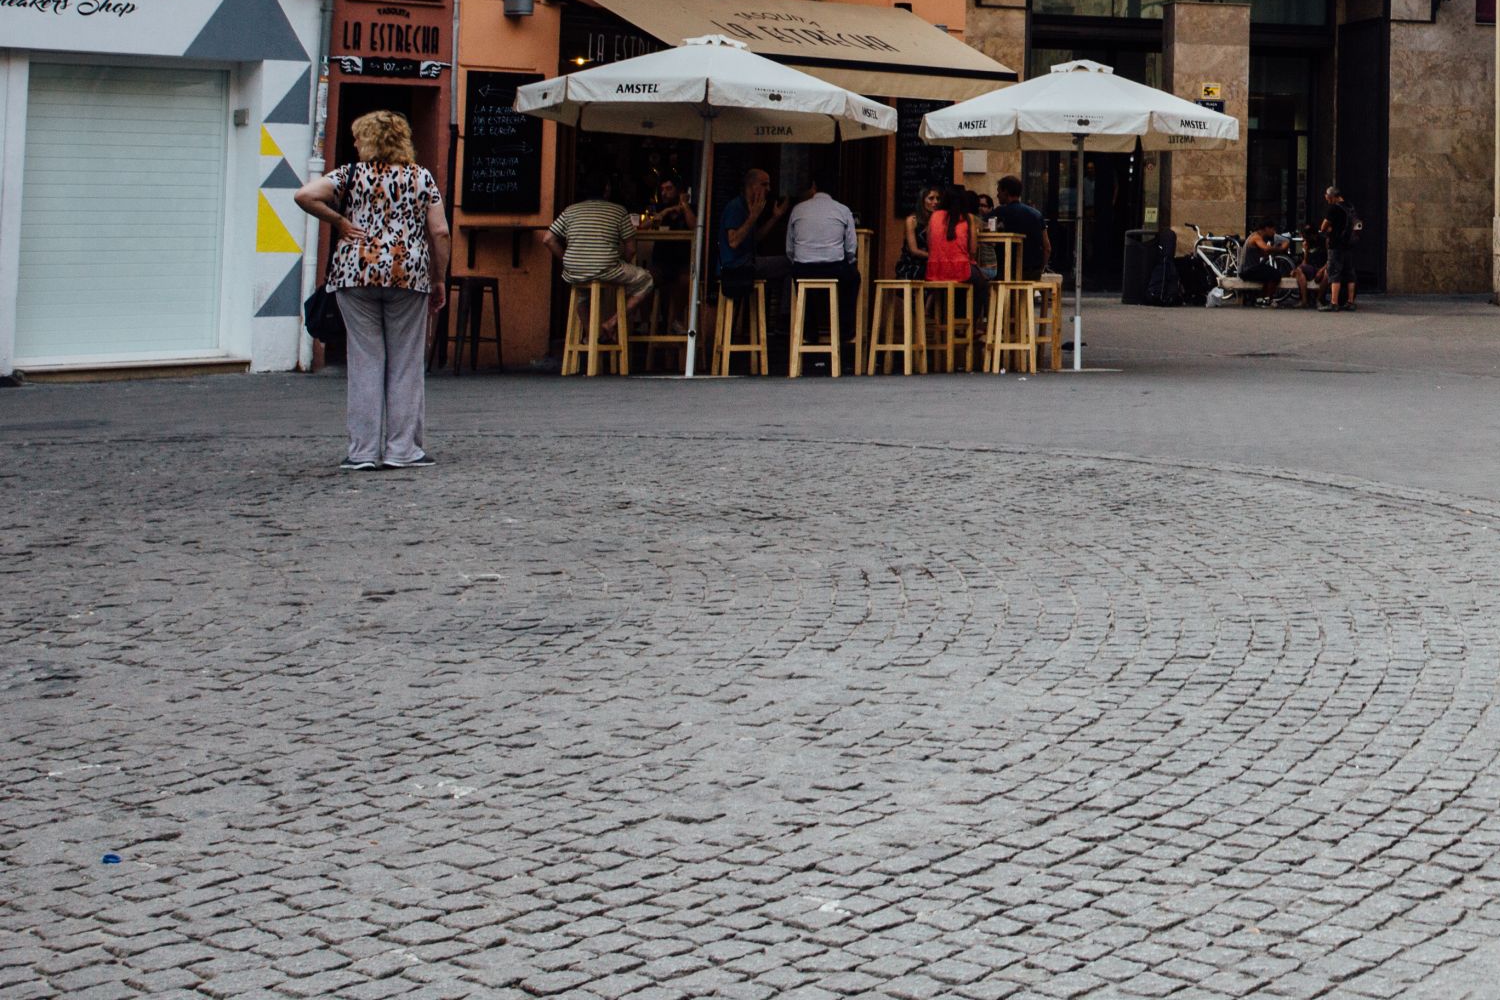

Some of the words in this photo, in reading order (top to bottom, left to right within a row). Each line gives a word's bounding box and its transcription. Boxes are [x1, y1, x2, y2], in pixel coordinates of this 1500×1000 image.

[710, 20, 763, 41] LA
[343, 21, 362, 51] LA
[370, 22, 440, 55] ESTRECHA
[616, 83, 660, 94] AMSTEL
[957, 119, 988, 131] AMSTEL
[1180, 119, 1208, 130] AMSTEL
